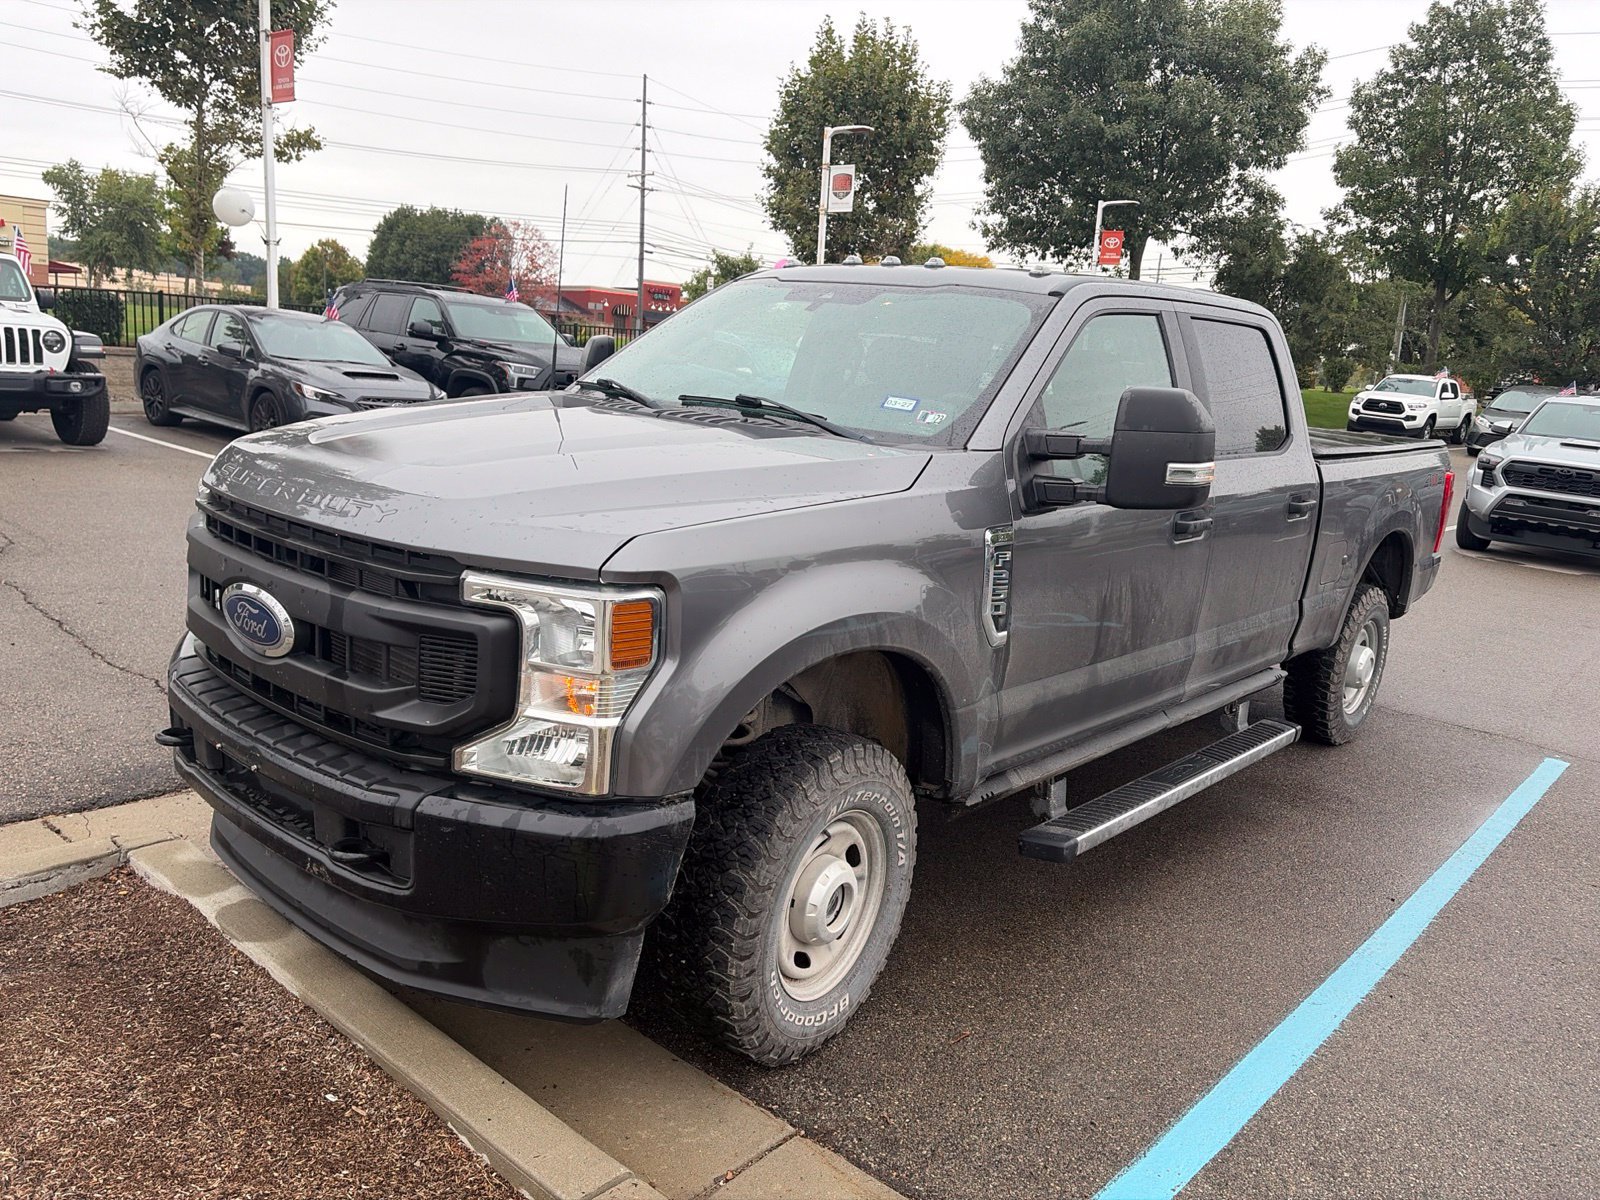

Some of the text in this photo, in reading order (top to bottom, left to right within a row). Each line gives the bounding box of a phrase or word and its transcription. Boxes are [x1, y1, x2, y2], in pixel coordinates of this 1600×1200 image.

[221, 463, 399, 523] SUPER DUTY
[233, 601, 268, 639] Ford
[896, 829, 906, 866] T/A
[770, 970, 850, 1027] BFGoodrich
